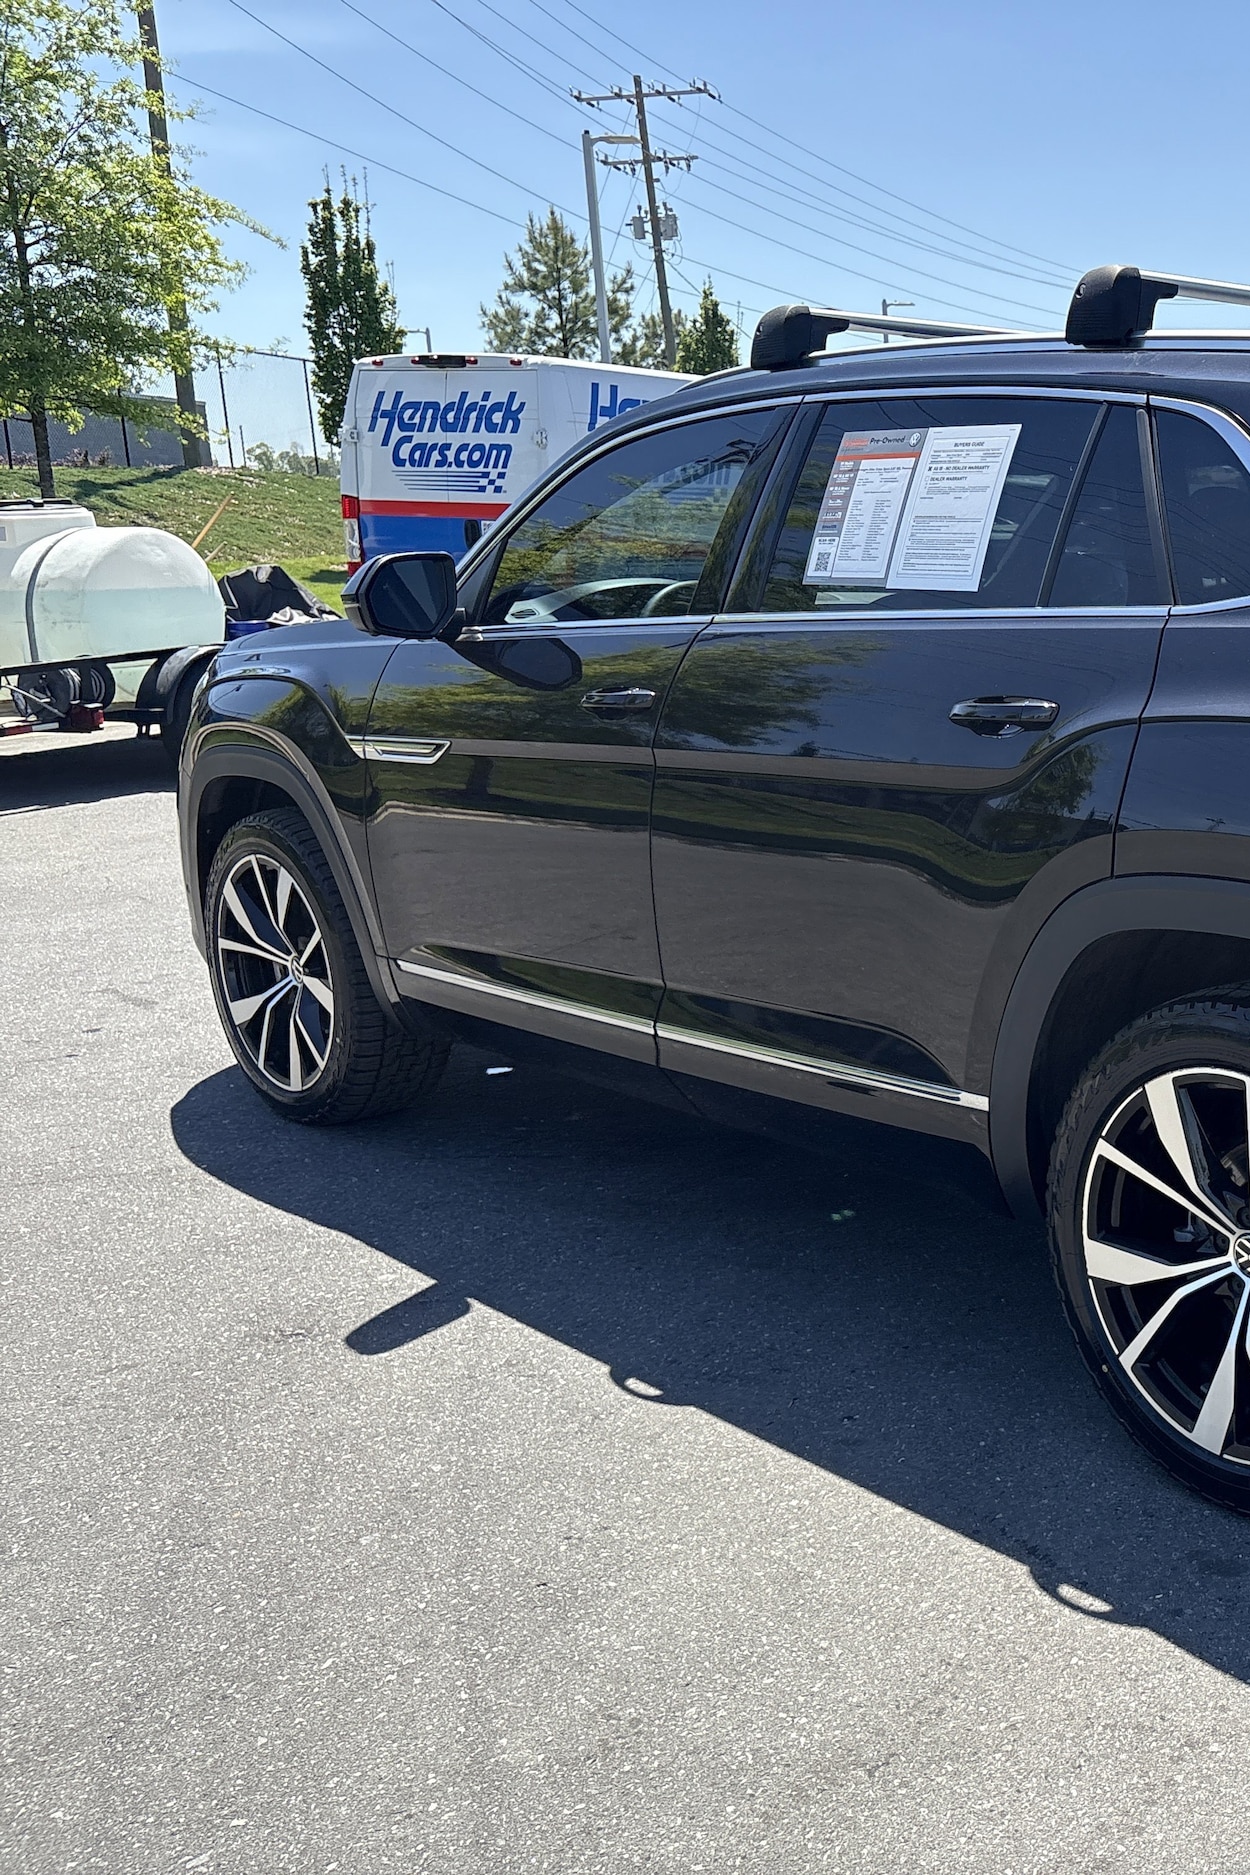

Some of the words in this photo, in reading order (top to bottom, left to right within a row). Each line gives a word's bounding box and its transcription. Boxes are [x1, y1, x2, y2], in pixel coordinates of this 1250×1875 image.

[367, 390, 526, 447] Hendrick
[392, 435, 512, 469] Cars.com
[869, 435, 906, 445] Pre-Owned
